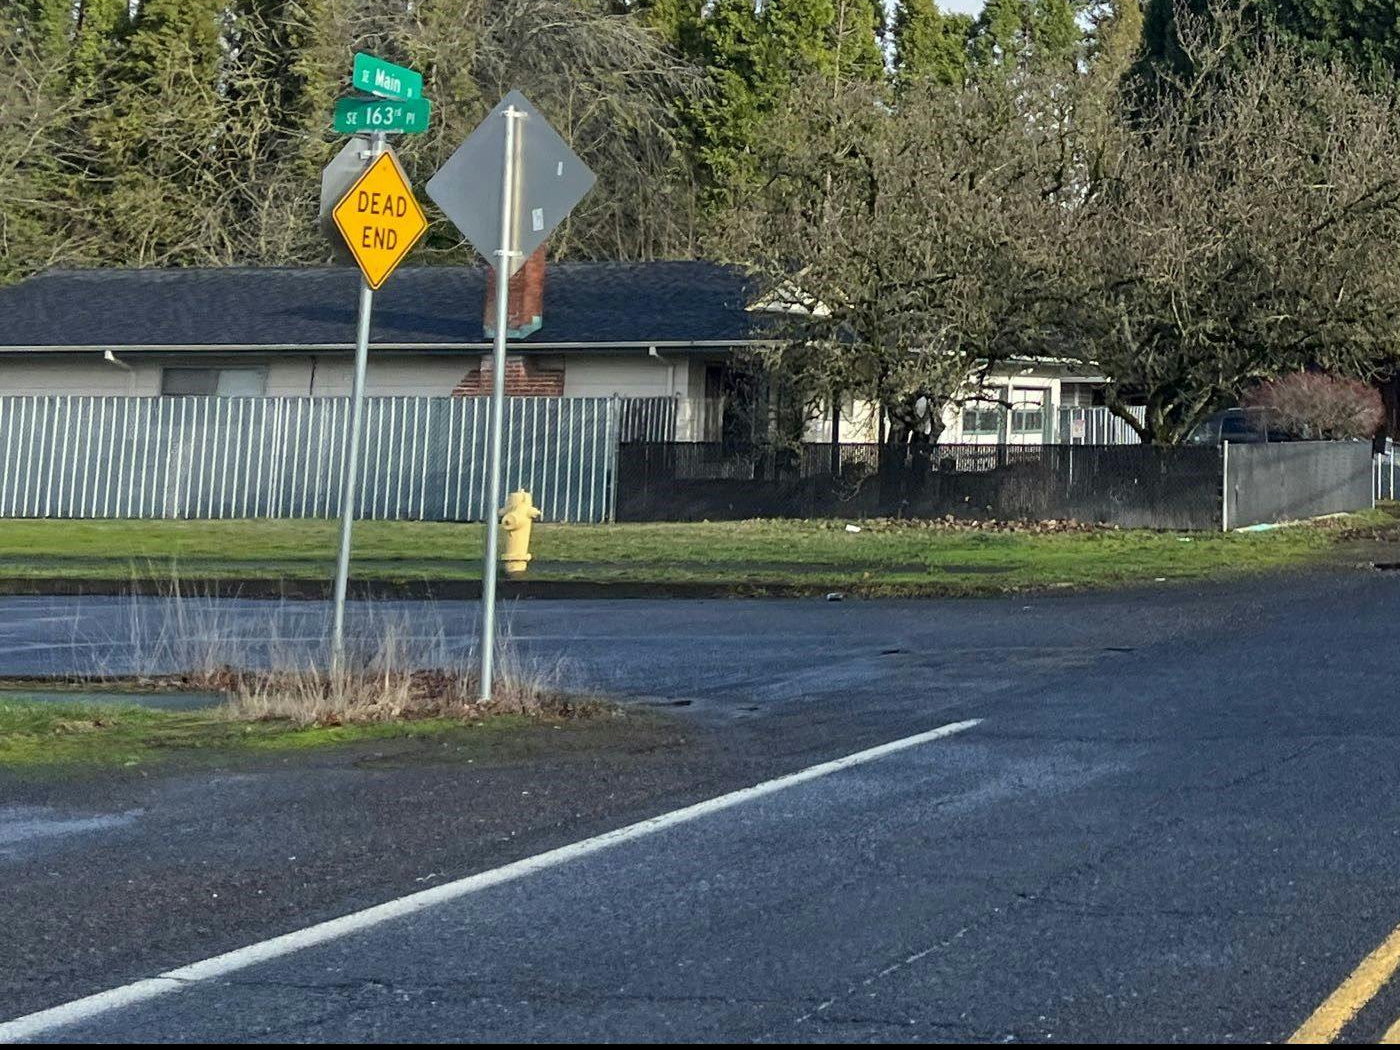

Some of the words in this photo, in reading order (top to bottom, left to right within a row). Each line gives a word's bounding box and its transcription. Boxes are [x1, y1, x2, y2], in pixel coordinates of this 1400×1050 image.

[374, 68, 401, 93] Main
[345, 111, 358, 125] SE
[366, 106, 402, 125] 163rd
[357, 190, 407, 217] DEAD
[362, 226, 398, 250] END
